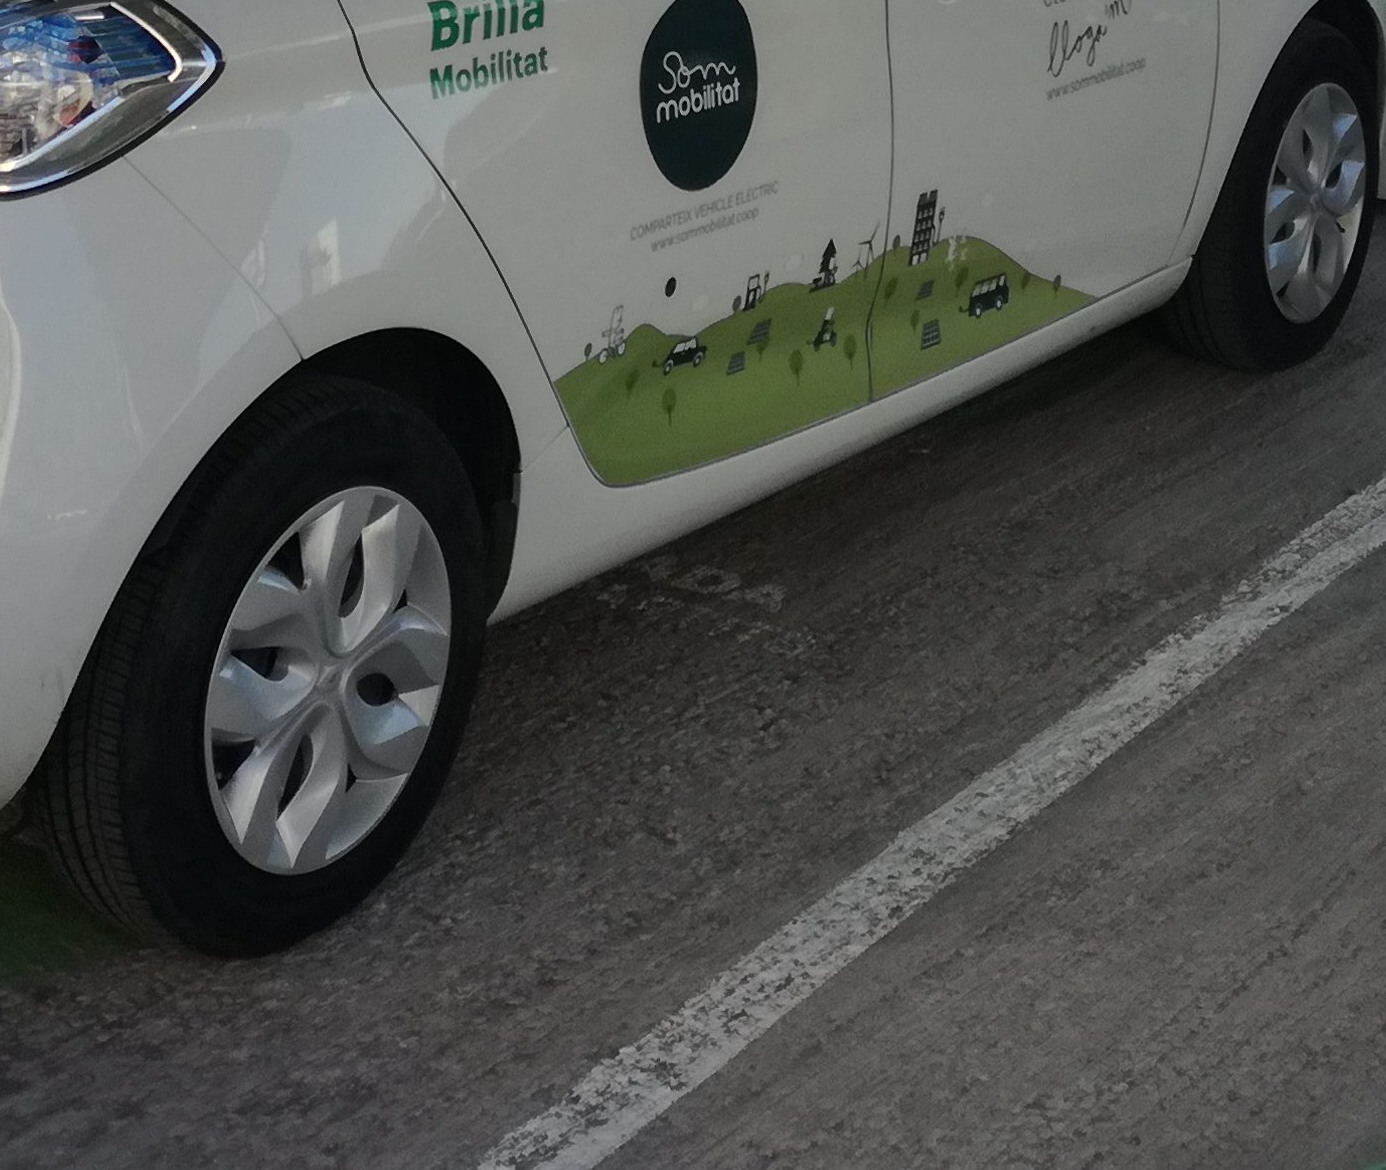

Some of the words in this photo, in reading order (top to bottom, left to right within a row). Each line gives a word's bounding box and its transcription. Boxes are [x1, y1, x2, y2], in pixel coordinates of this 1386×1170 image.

[429, 46, 549, 100] Mobilitat
[658, 51, 736, 95] Som
[656, 76, 741, 124] mobilitat
[630, 207, 693, 241] COMPARTEIX
[694, 194, 734, 220] VEHICLE
